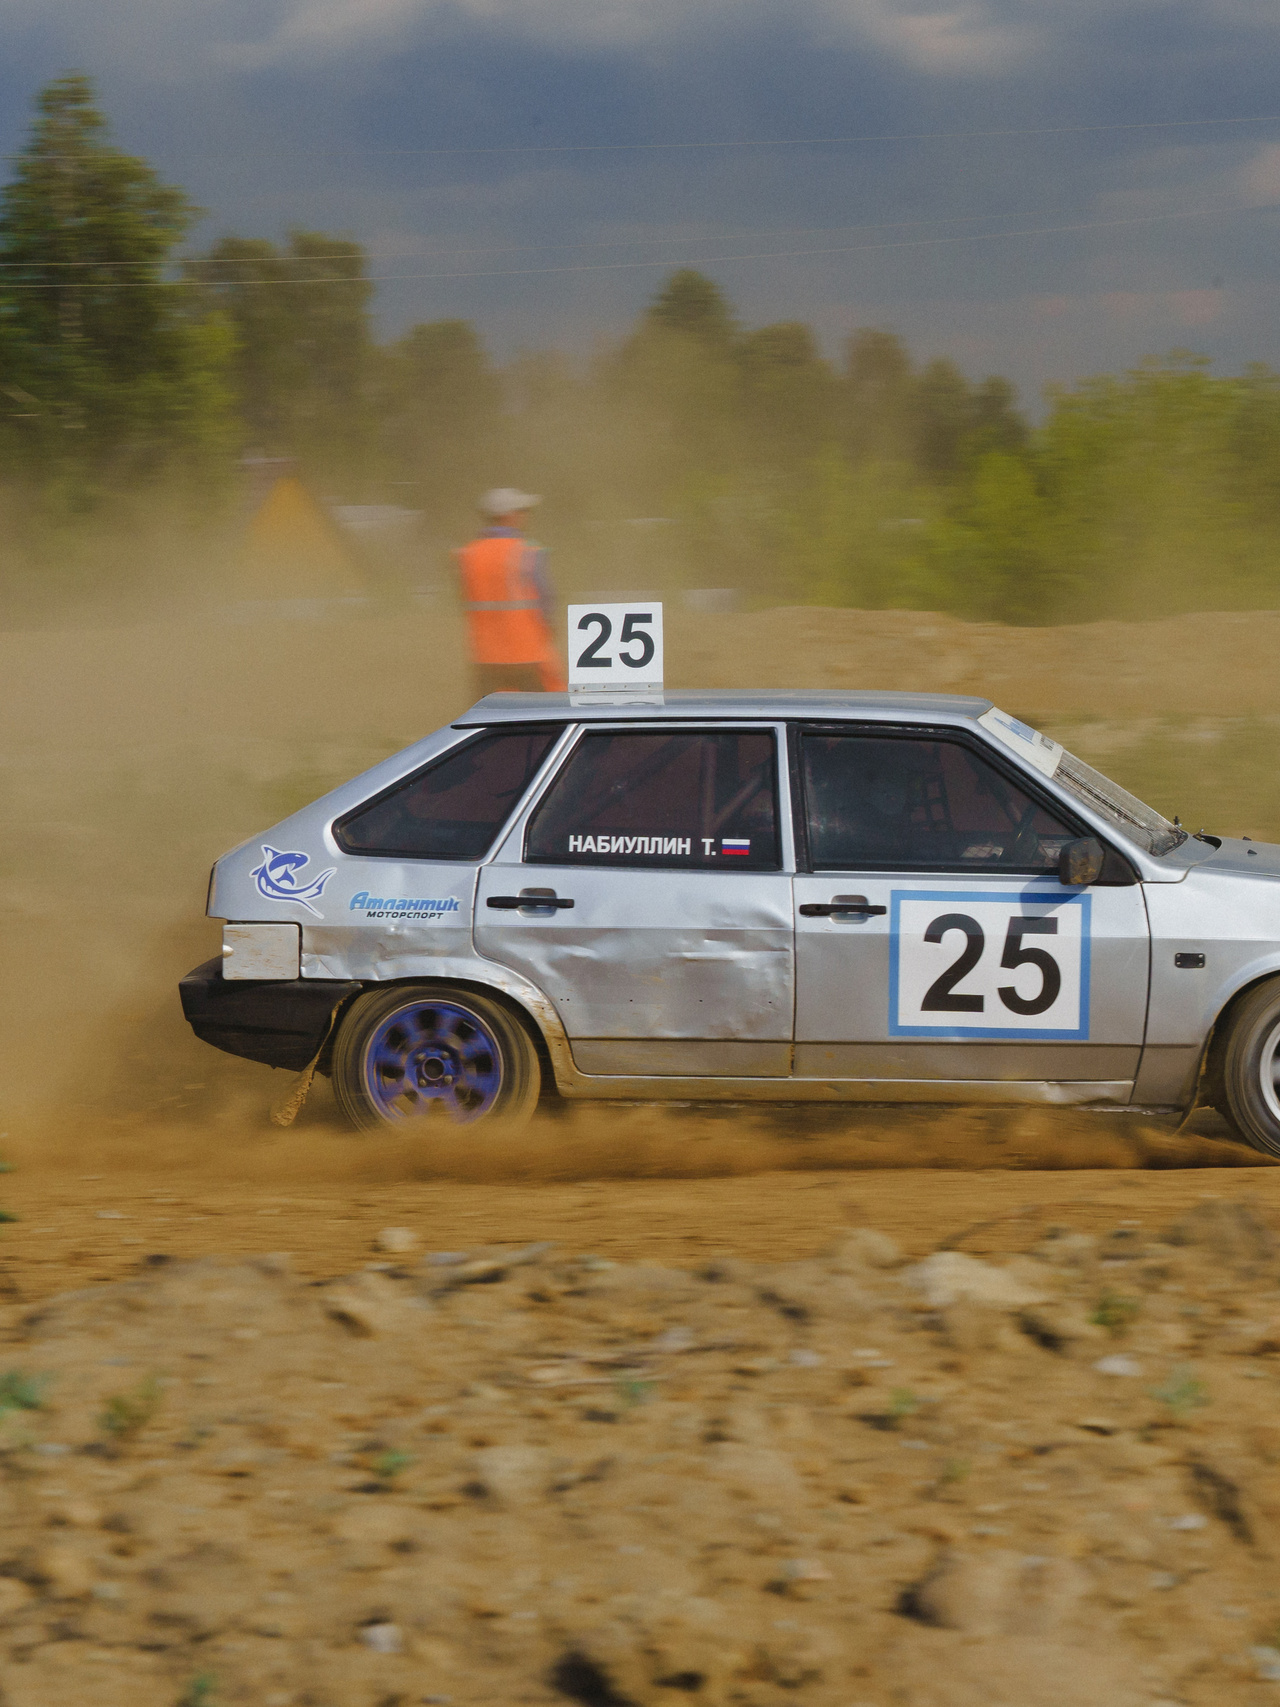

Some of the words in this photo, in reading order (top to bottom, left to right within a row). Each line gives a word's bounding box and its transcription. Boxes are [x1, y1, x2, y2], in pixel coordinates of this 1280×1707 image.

[576, 612, 655, 668] 25
[568, 834, 691, 855] НАБИУЛЛИН
[701, 838, 717, 856] Т.
[349, 891, 460, 912] Атлантик
[366, 911, 444, 919] МОТОРСПОРТ
[920, 913, 1061, 1016] 25
